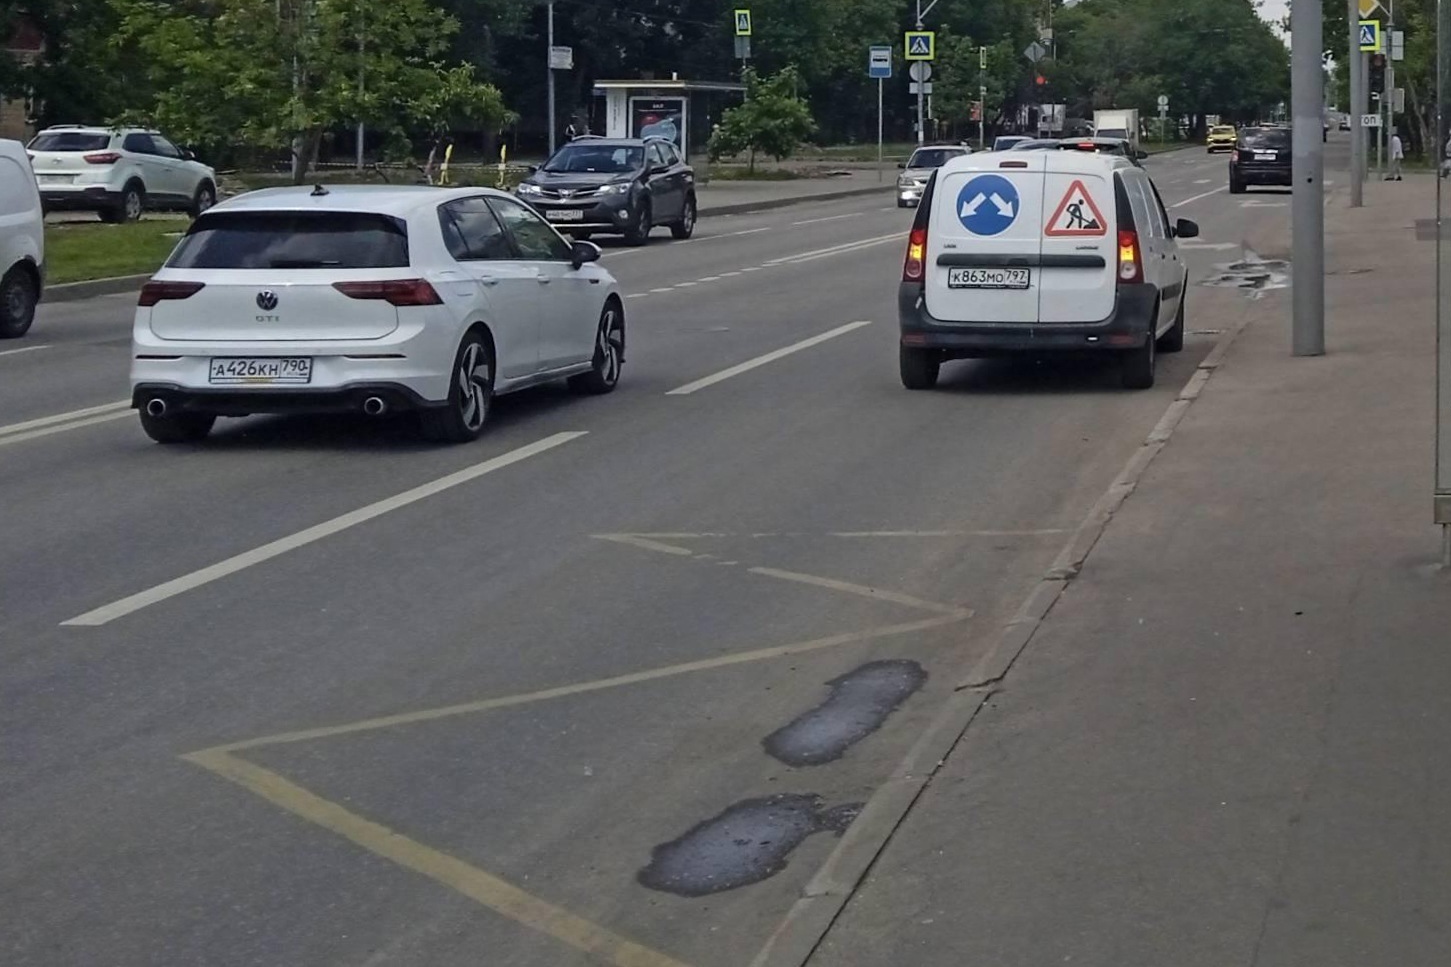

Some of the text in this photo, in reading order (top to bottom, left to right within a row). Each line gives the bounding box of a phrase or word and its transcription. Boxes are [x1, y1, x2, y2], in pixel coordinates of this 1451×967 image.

[953, 269, 1026, 283] К863МО 797
[215, 359, 306, 376] А426КН 790
